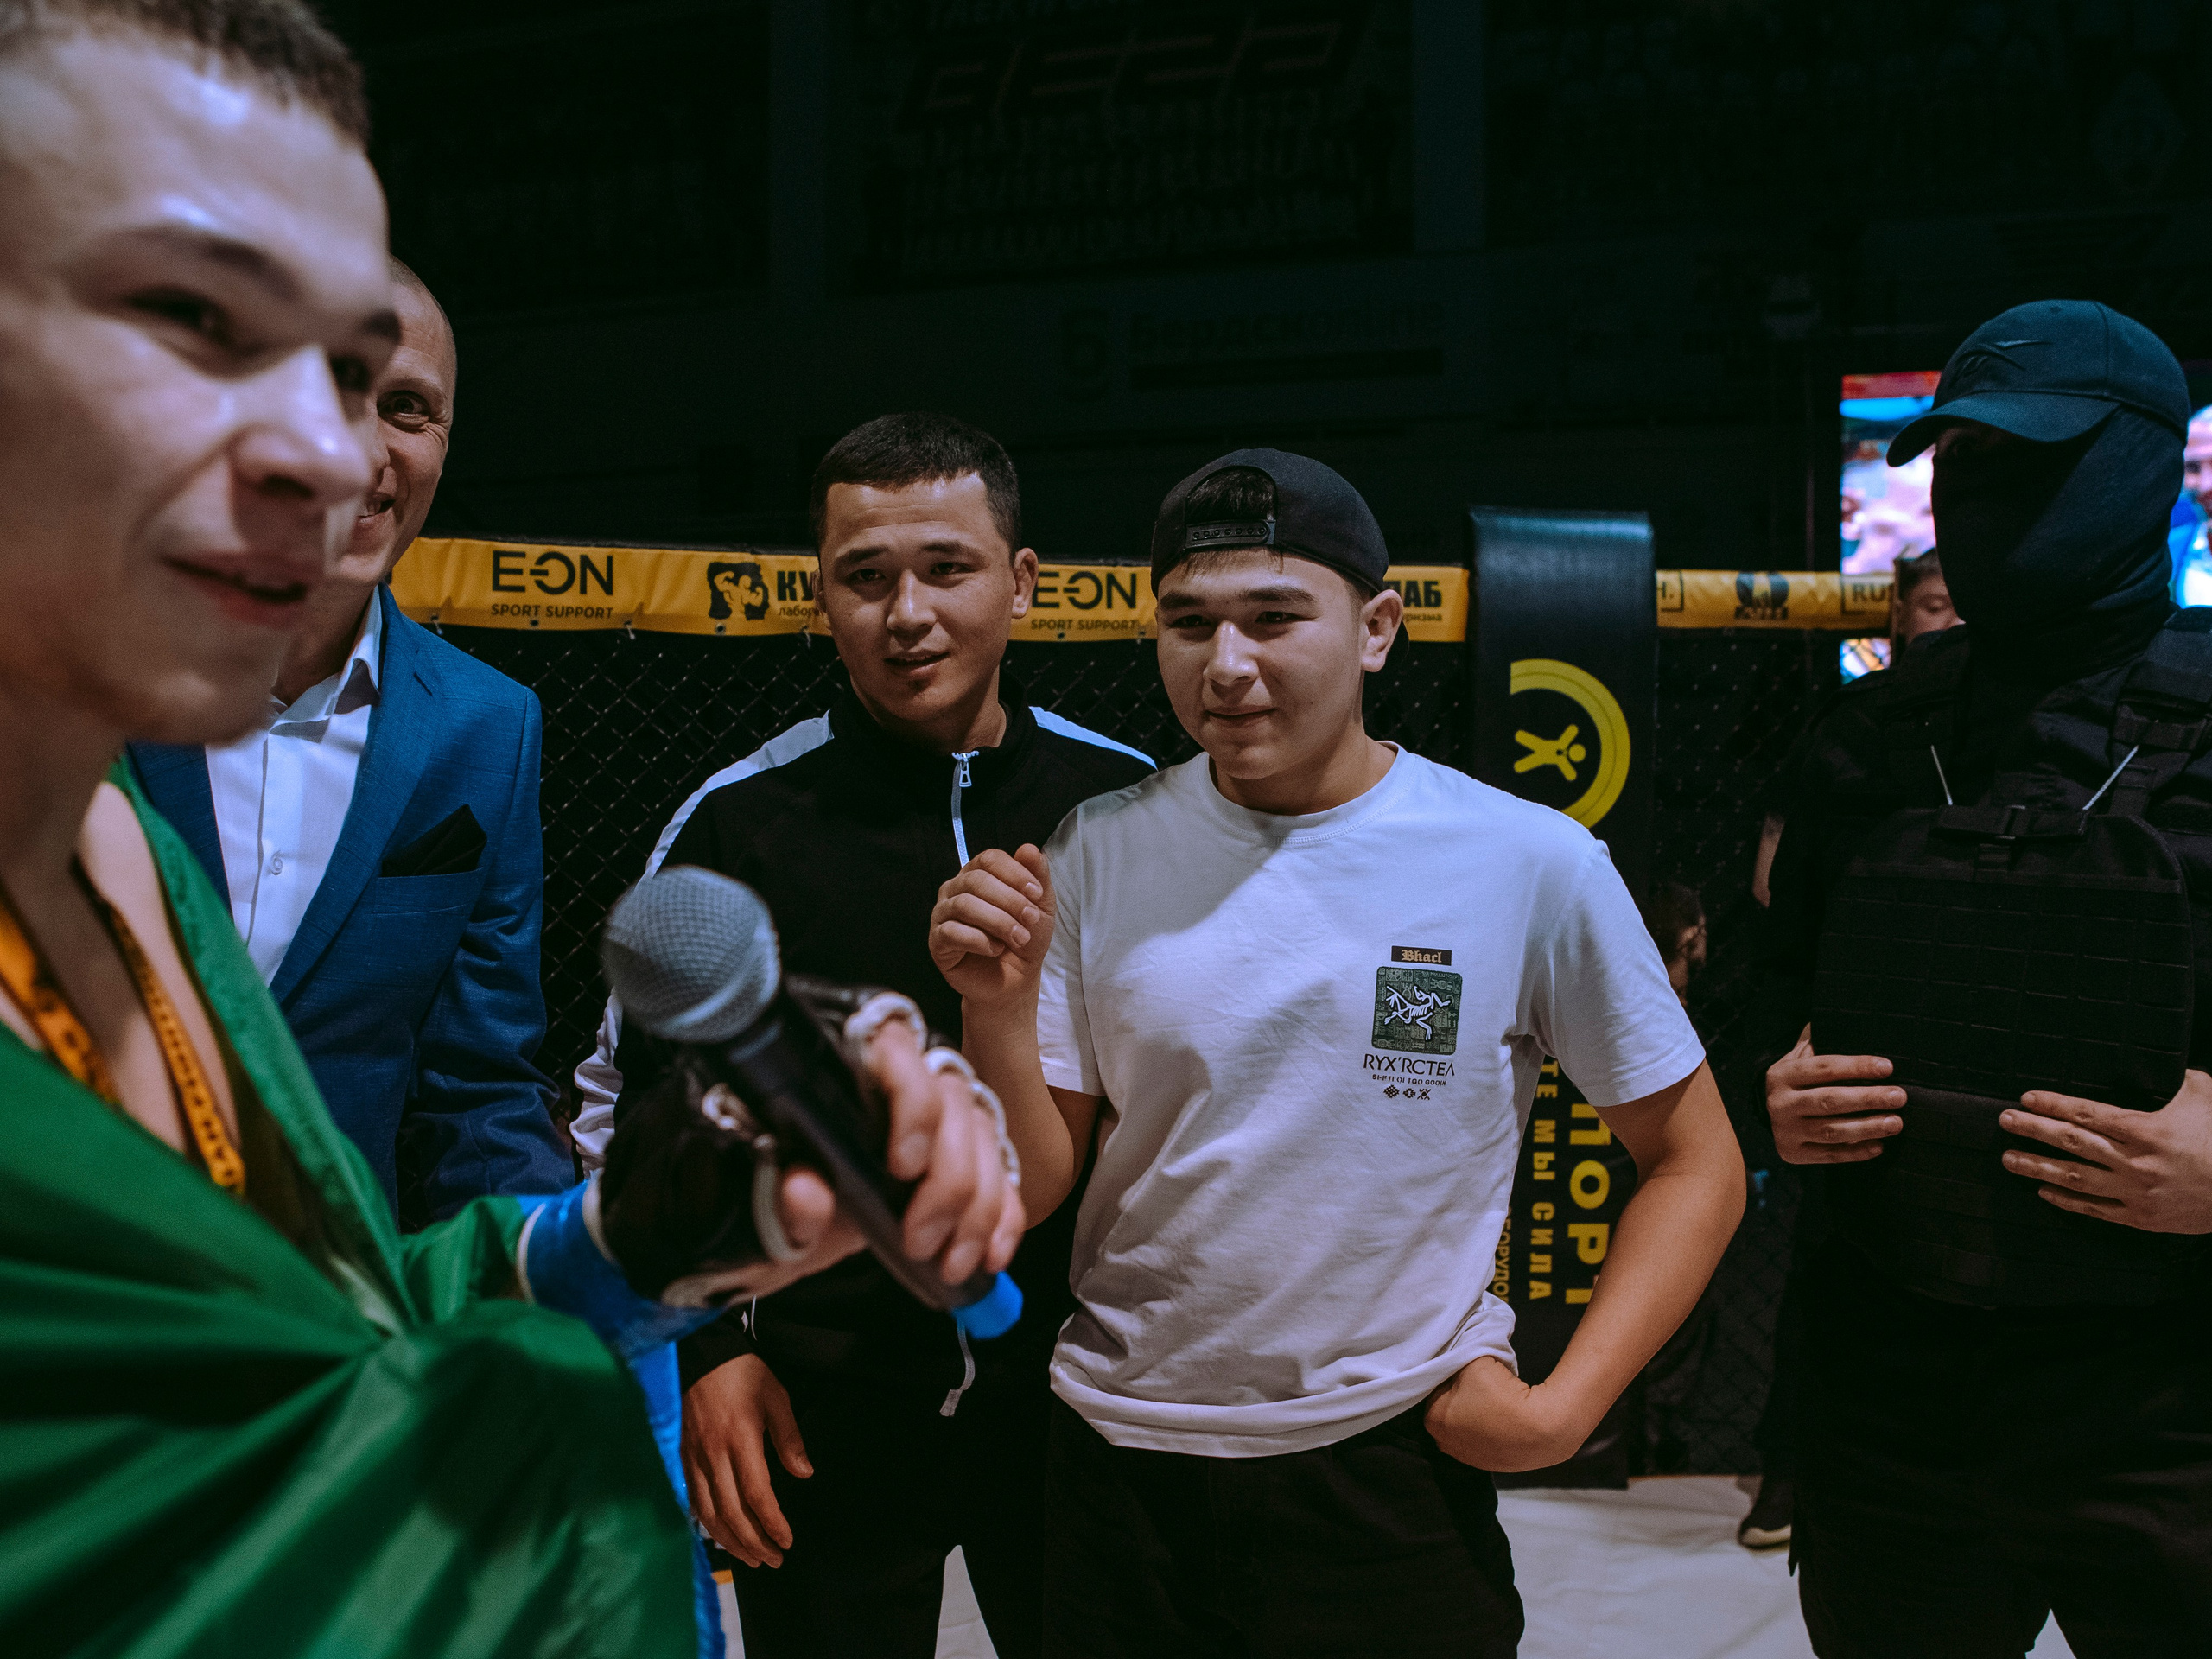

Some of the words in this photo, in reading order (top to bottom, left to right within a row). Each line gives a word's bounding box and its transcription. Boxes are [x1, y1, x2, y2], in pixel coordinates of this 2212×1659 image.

[491, 604, 541, 617] SPORT
[546, 606, 613, 619] SUPPORT
[1031, 619, 1073, 630] SPORT
[1077, 620, 1138, 631] SUPPORT
[1532, 1119, 1556, 1180] МЫ
[1529, 1202, 1555, 1300] СИЛА
